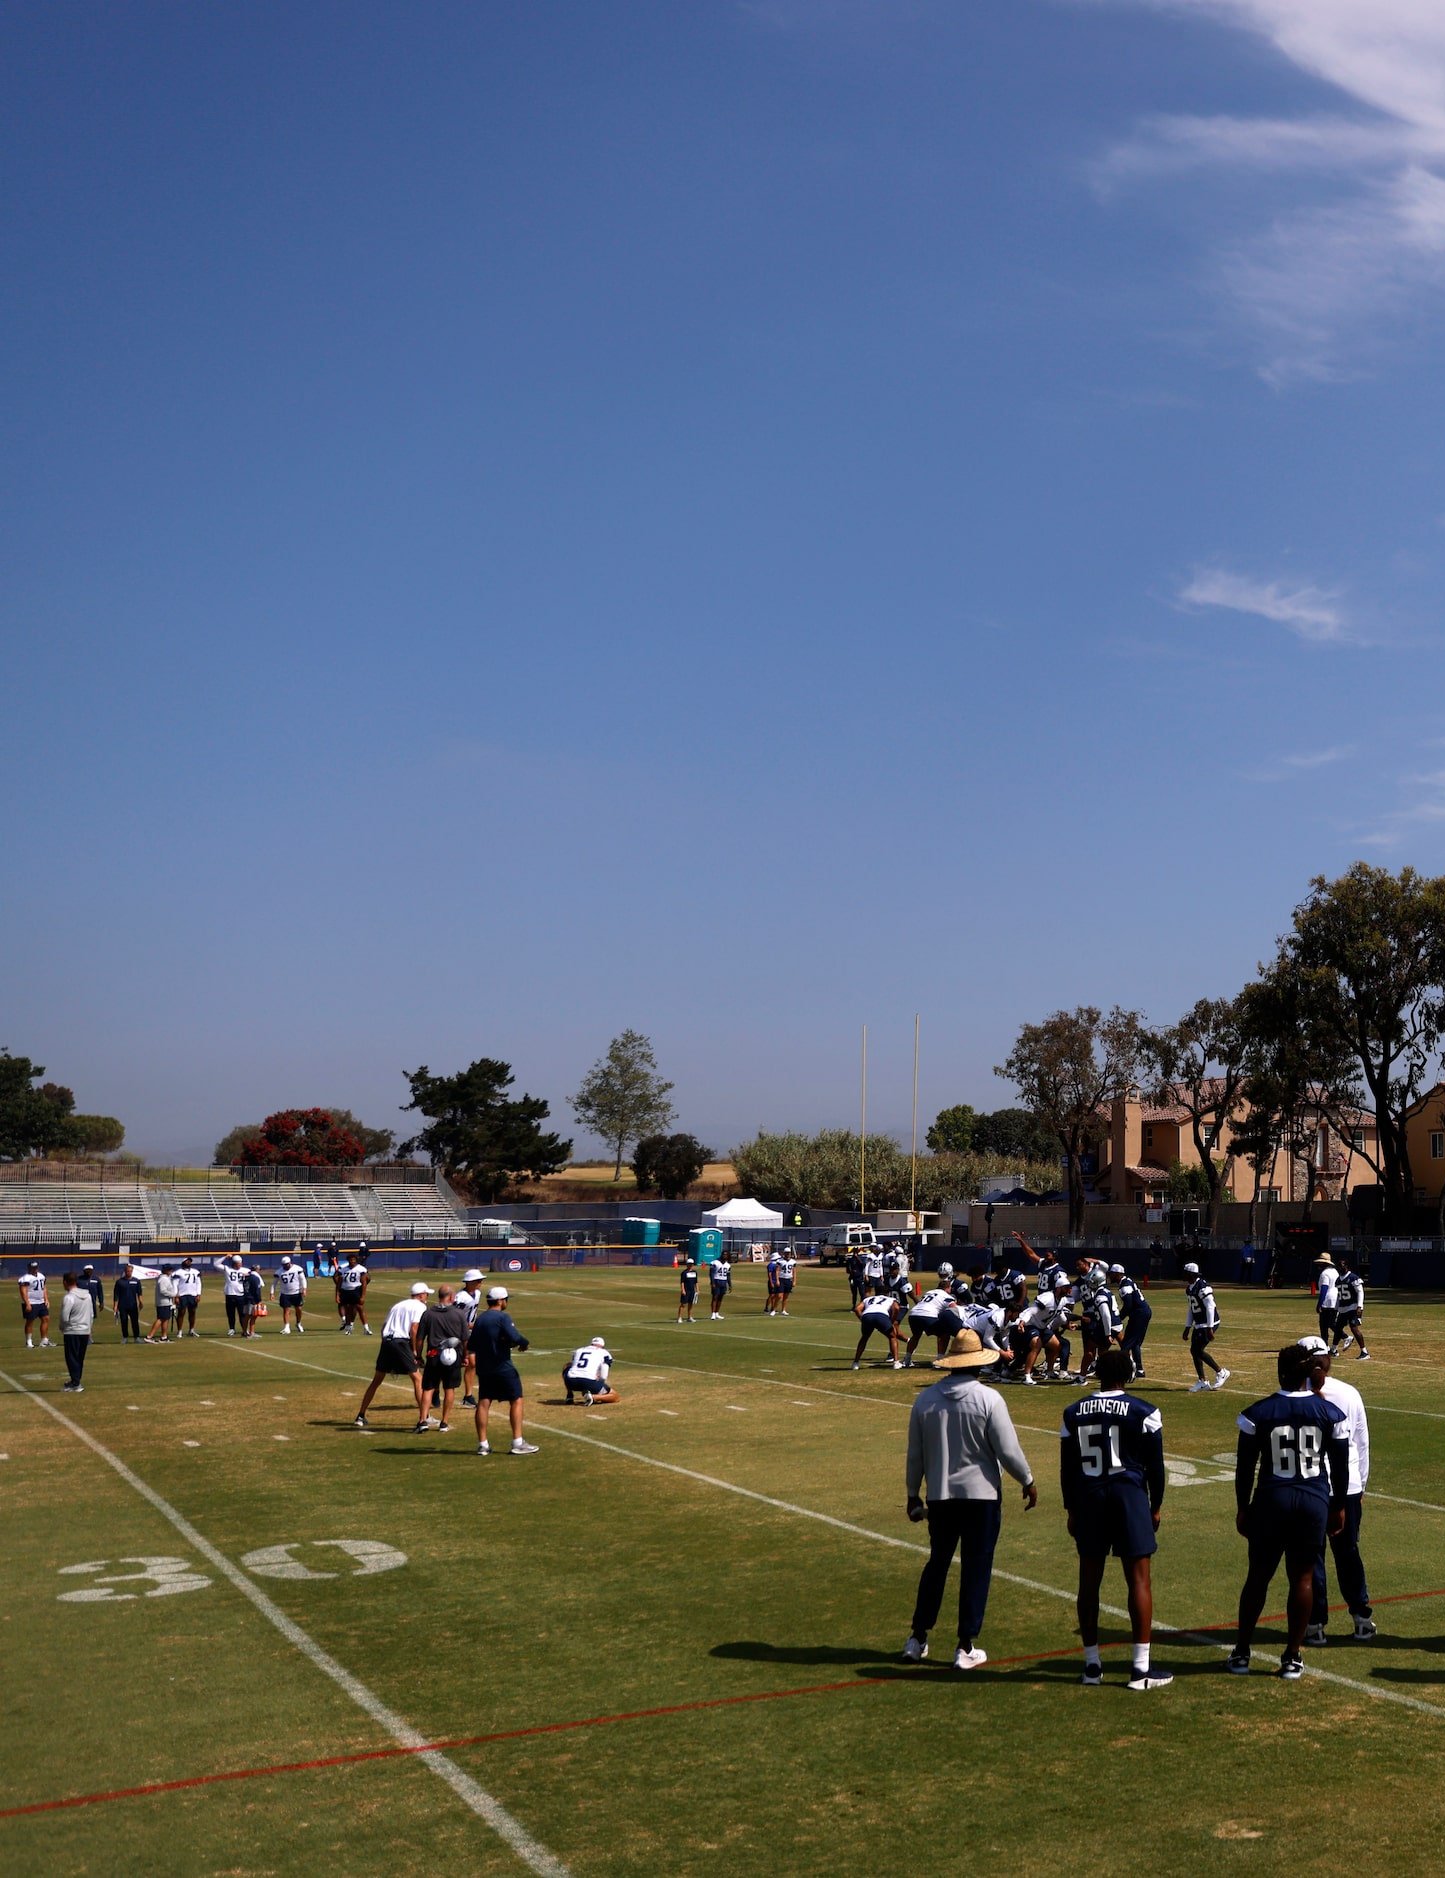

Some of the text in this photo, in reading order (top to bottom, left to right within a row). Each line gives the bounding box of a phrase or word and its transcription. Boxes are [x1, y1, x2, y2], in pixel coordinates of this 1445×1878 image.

[184, 1273, 197, 1284] 71
[281, 1272, 296, 1284] 67
[343, 1272, 357, 1283] 78
[576, 1351, 592, 1369] 5
[1075, 1397, 1131, 1418] JOHNSON
[1077, 1423, 1127, 1478] 51
[1269, 1424, 1323, 1479] 68
